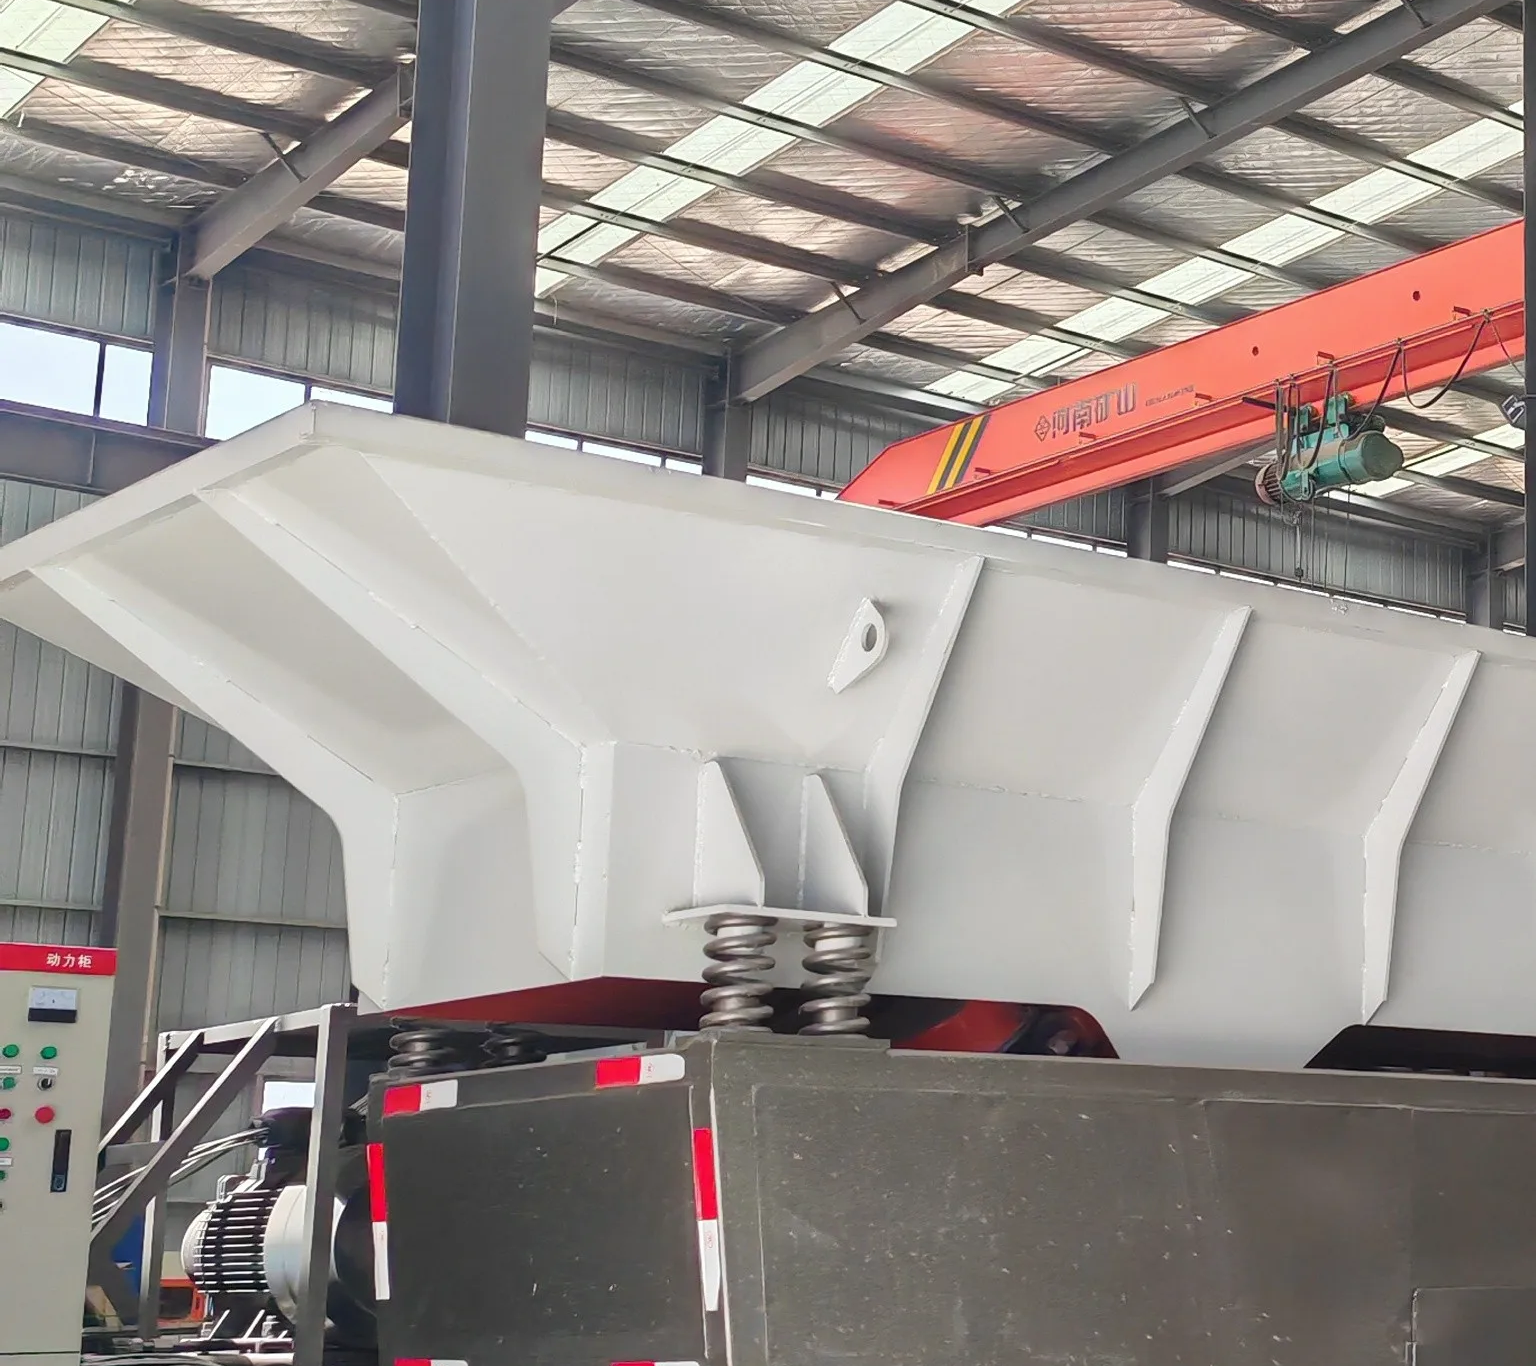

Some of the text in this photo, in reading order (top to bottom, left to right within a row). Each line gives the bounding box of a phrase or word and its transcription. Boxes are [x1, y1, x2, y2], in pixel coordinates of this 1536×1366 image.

[1052, 382, 1136, 439] 河南矿山
[46, 952, 92, 968] 动力柜
